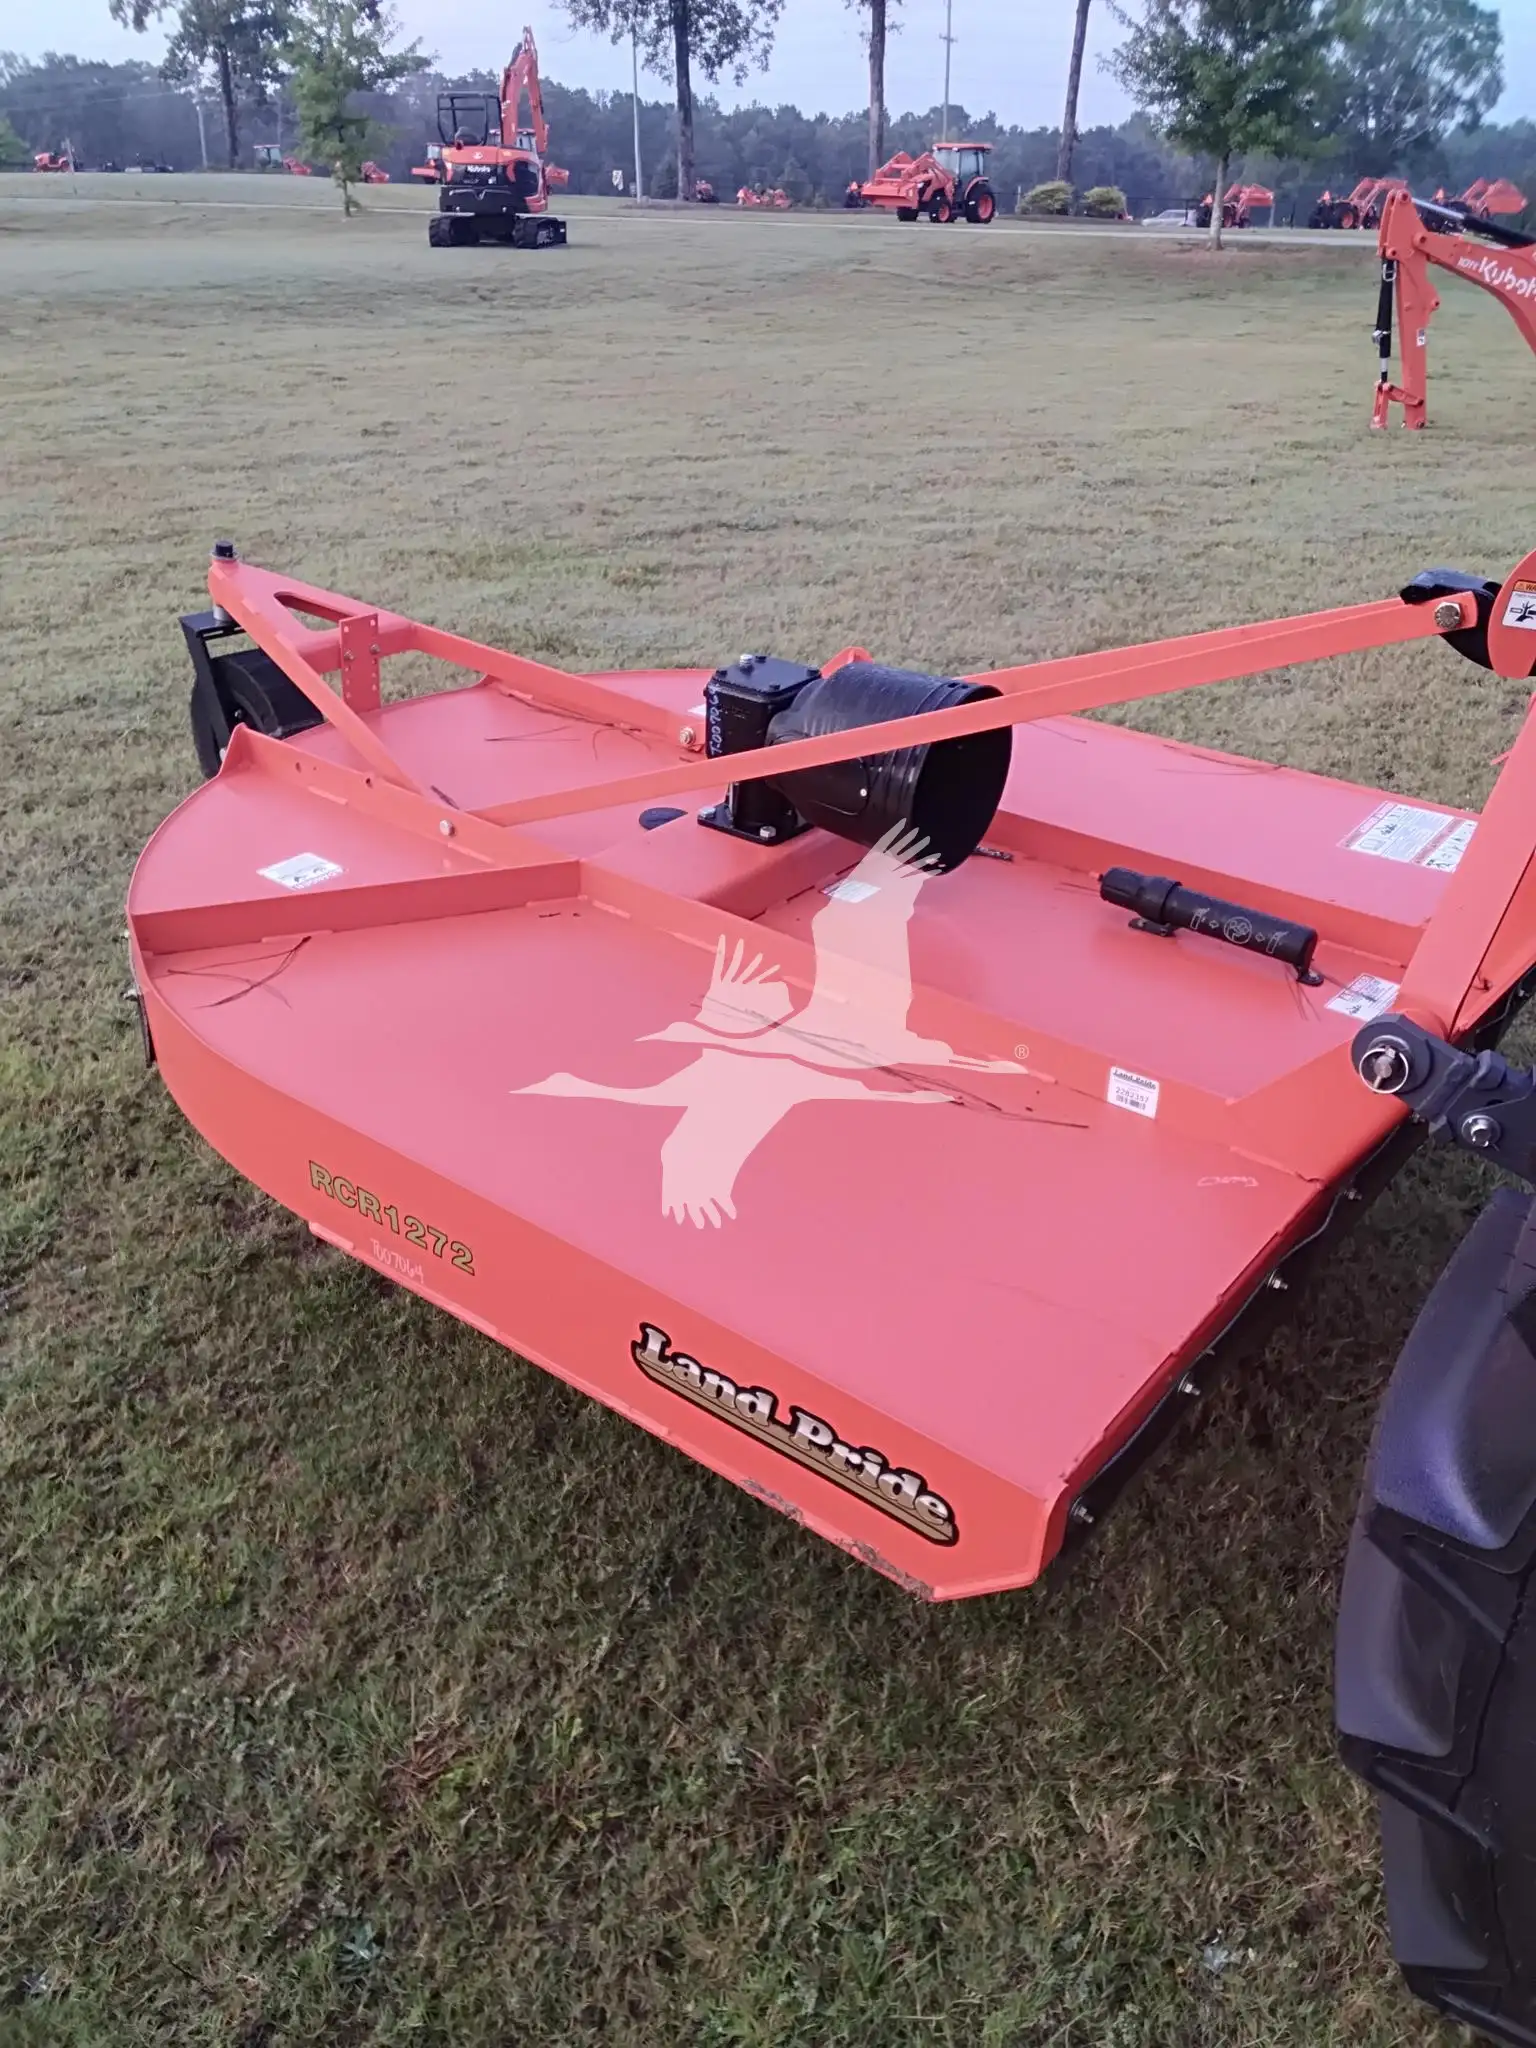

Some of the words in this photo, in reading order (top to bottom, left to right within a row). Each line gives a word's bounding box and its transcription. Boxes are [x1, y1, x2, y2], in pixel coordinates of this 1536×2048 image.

[1477, 256, 1536, 301] Kubot
[308, 1159, 476, 1276] RCR1272
[637, 1323, 777, 1427] Land
[788, 1406, 952, 1526] Pride
